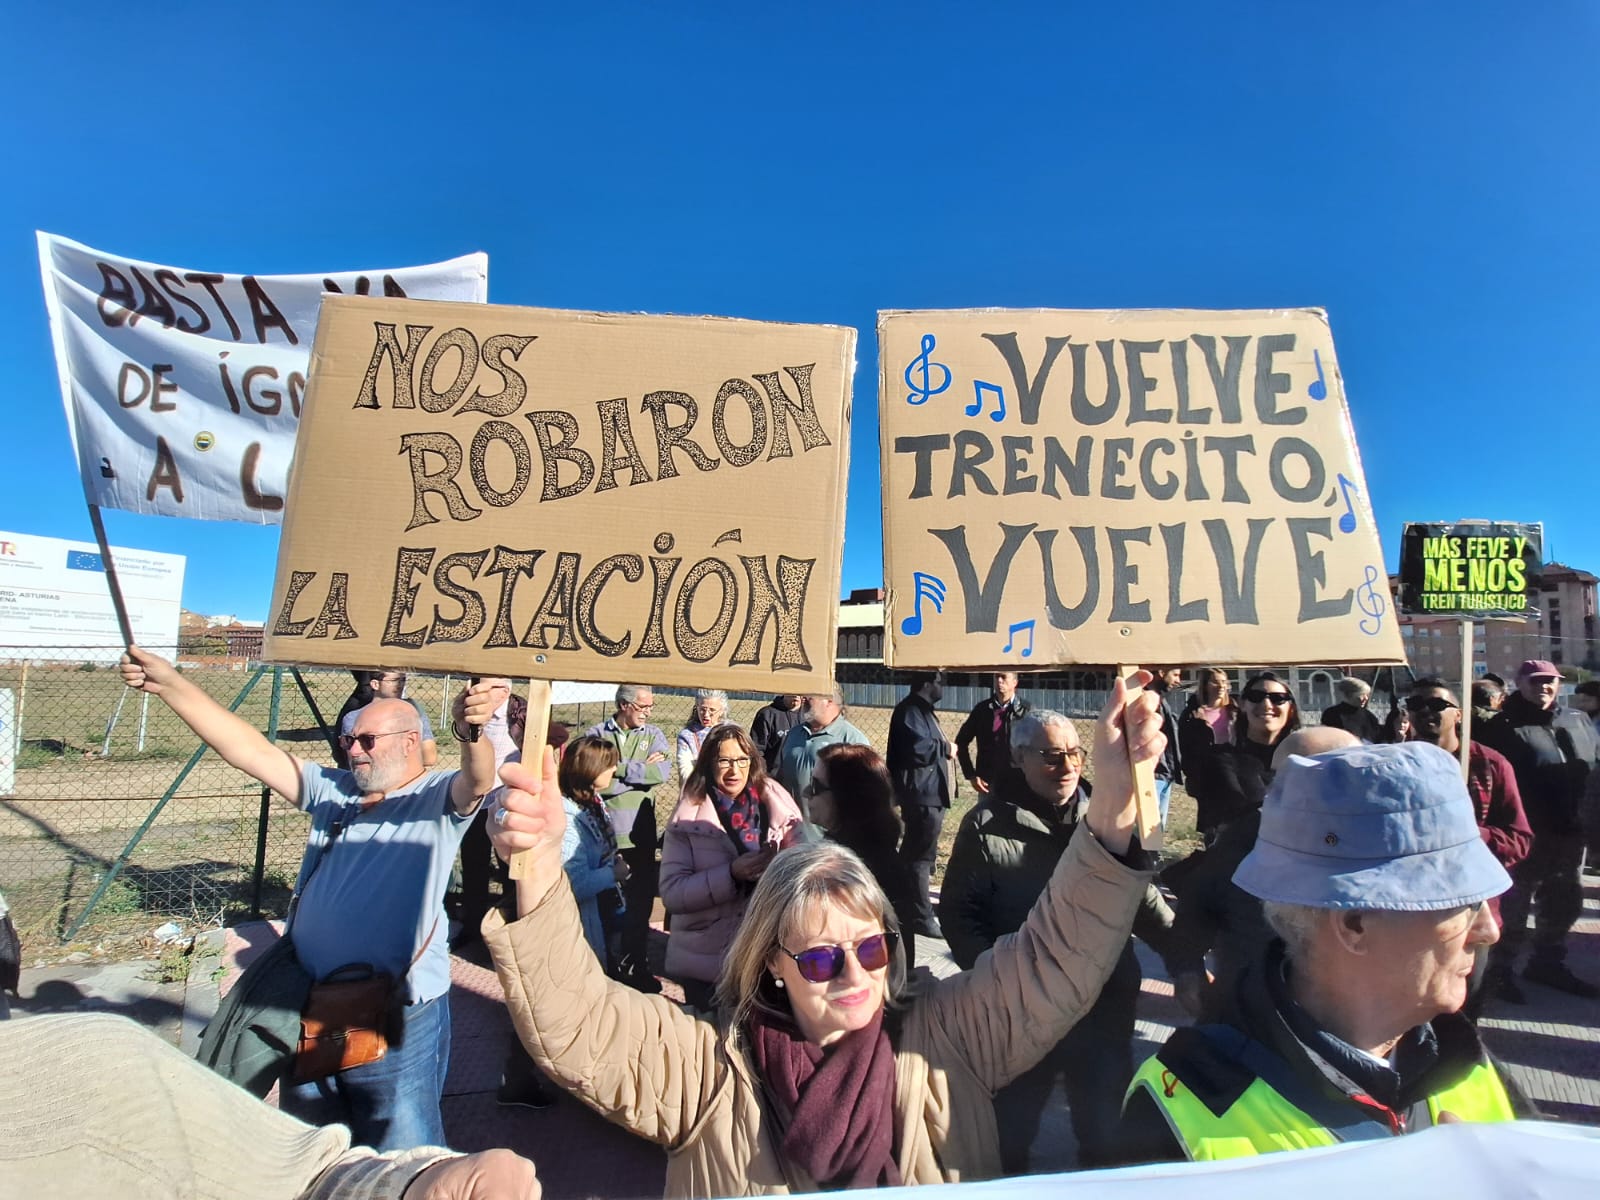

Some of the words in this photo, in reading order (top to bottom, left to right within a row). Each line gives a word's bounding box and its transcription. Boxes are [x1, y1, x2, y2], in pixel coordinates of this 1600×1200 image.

[96, 261, 298, 345] BASTA
[118, 362, 179, 413] DE
[353, 321, 539, 417] NOS
[981, 332, 1307, 426] VUELVE
[146, 435, 184, 504] A
[398, 362, 831, 532] ROBARON
[927, 517, 1354, 634] VUELVE
[1423, 534, 1461, 558] MÁS
[1467, 537, 1510, 558] FEVE
[1514, 537, 1527, 558] Y
[1424, 558, 1527, 592] MENOS
[272, 571, 358, 640] LA
[1421, 593, 1456, 609] TREN
[1461, 591, 1527, 610] TURÍSTICO
